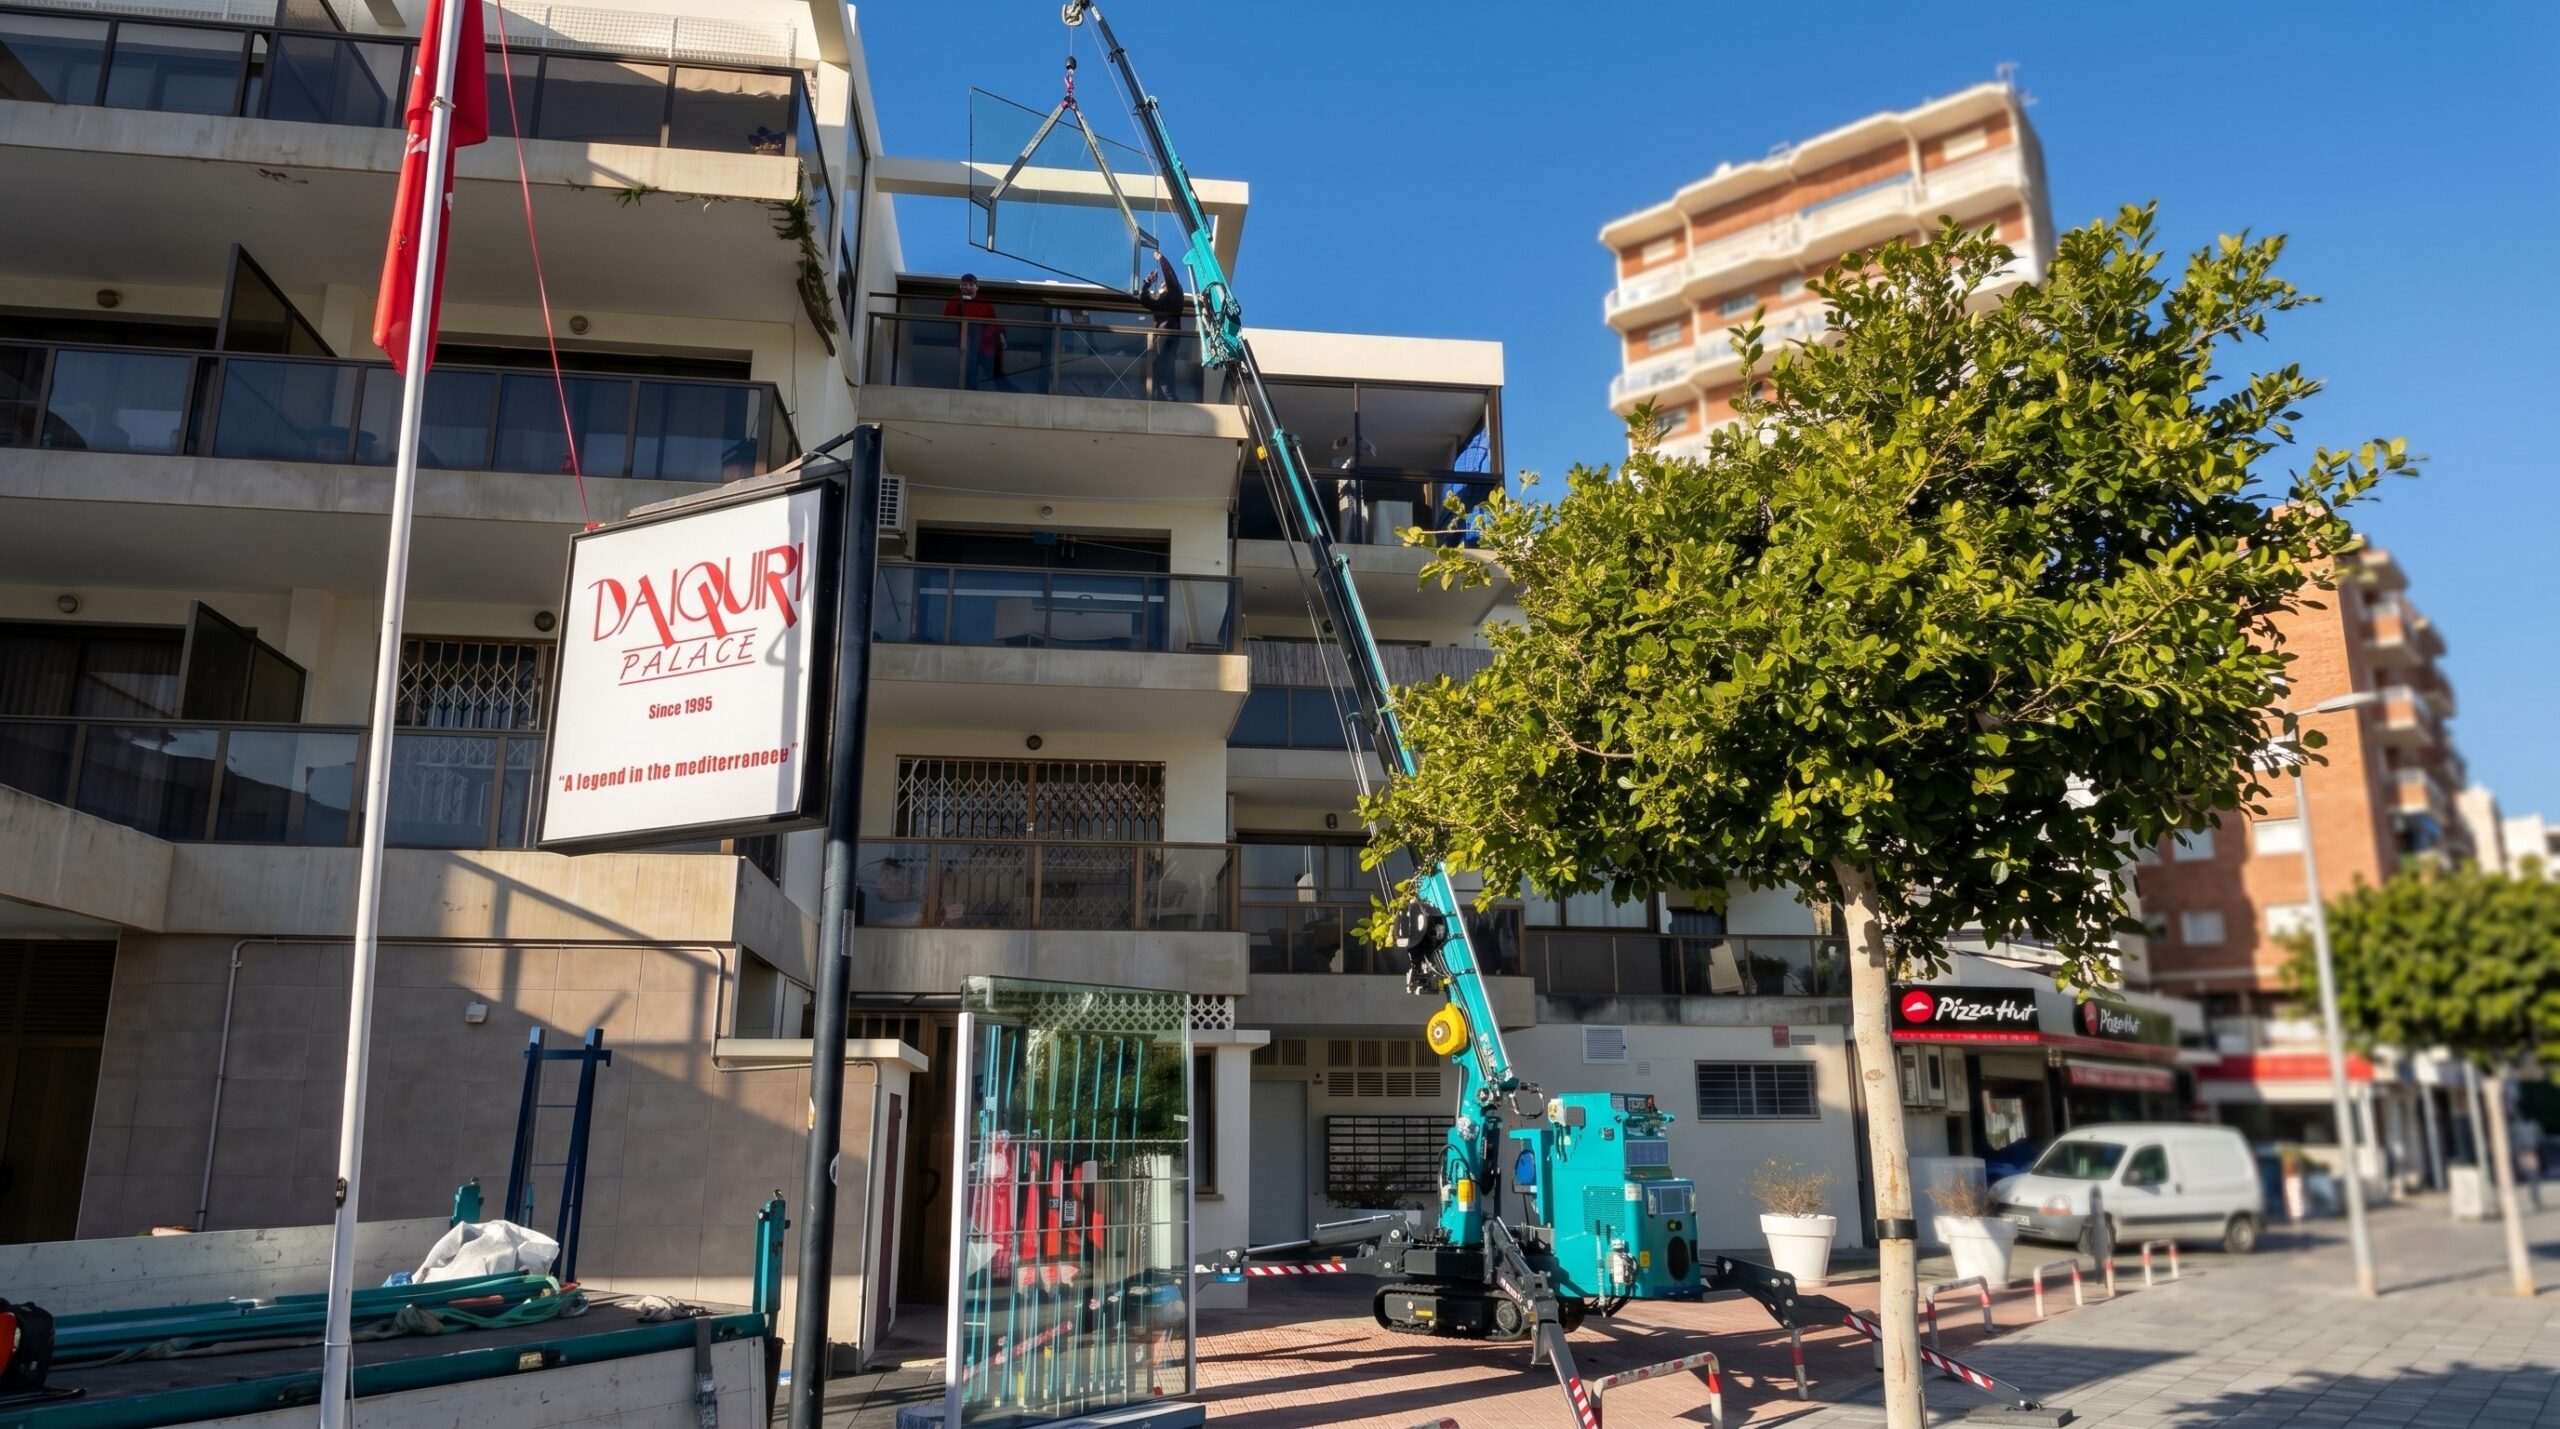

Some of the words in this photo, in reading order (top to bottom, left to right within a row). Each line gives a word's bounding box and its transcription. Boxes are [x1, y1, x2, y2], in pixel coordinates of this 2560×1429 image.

[619, 633, 756, 680] PALACE
[648, 703, 681, 719] Since
[685, 696, 713, 714] 1995
[576, 767, 626, 791] legend
[629, 766, 643, 783] in
[648, 762, 671, 780] the
[1935, 996, 1995, 1021] Pizza
[1996, 999, 2039, 1021] Hut
